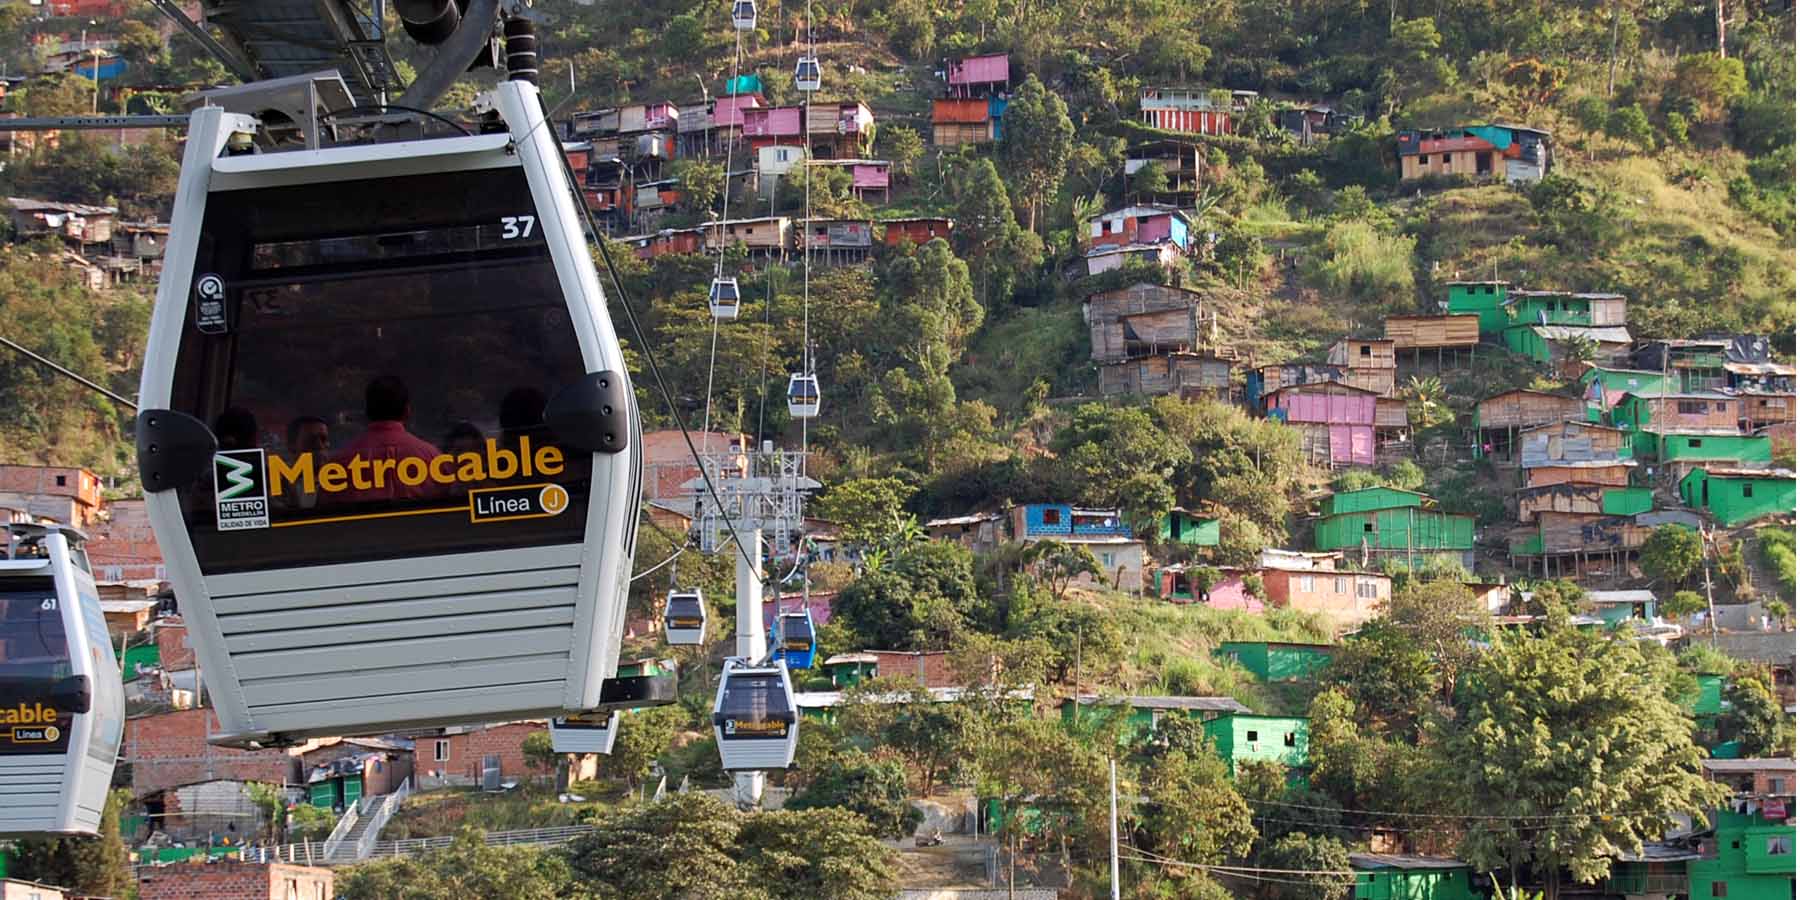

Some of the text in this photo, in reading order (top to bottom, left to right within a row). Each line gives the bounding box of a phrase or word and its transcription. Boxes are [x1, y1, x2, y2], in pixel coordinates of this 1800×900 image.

[501, 215, 535, 239] 37
[268, 437, 564, 496] Metrocable
[221, 501, 263, 511] METRO
[478, 496, 529, 515] Línea
[41, 599, 57, 610] 61
